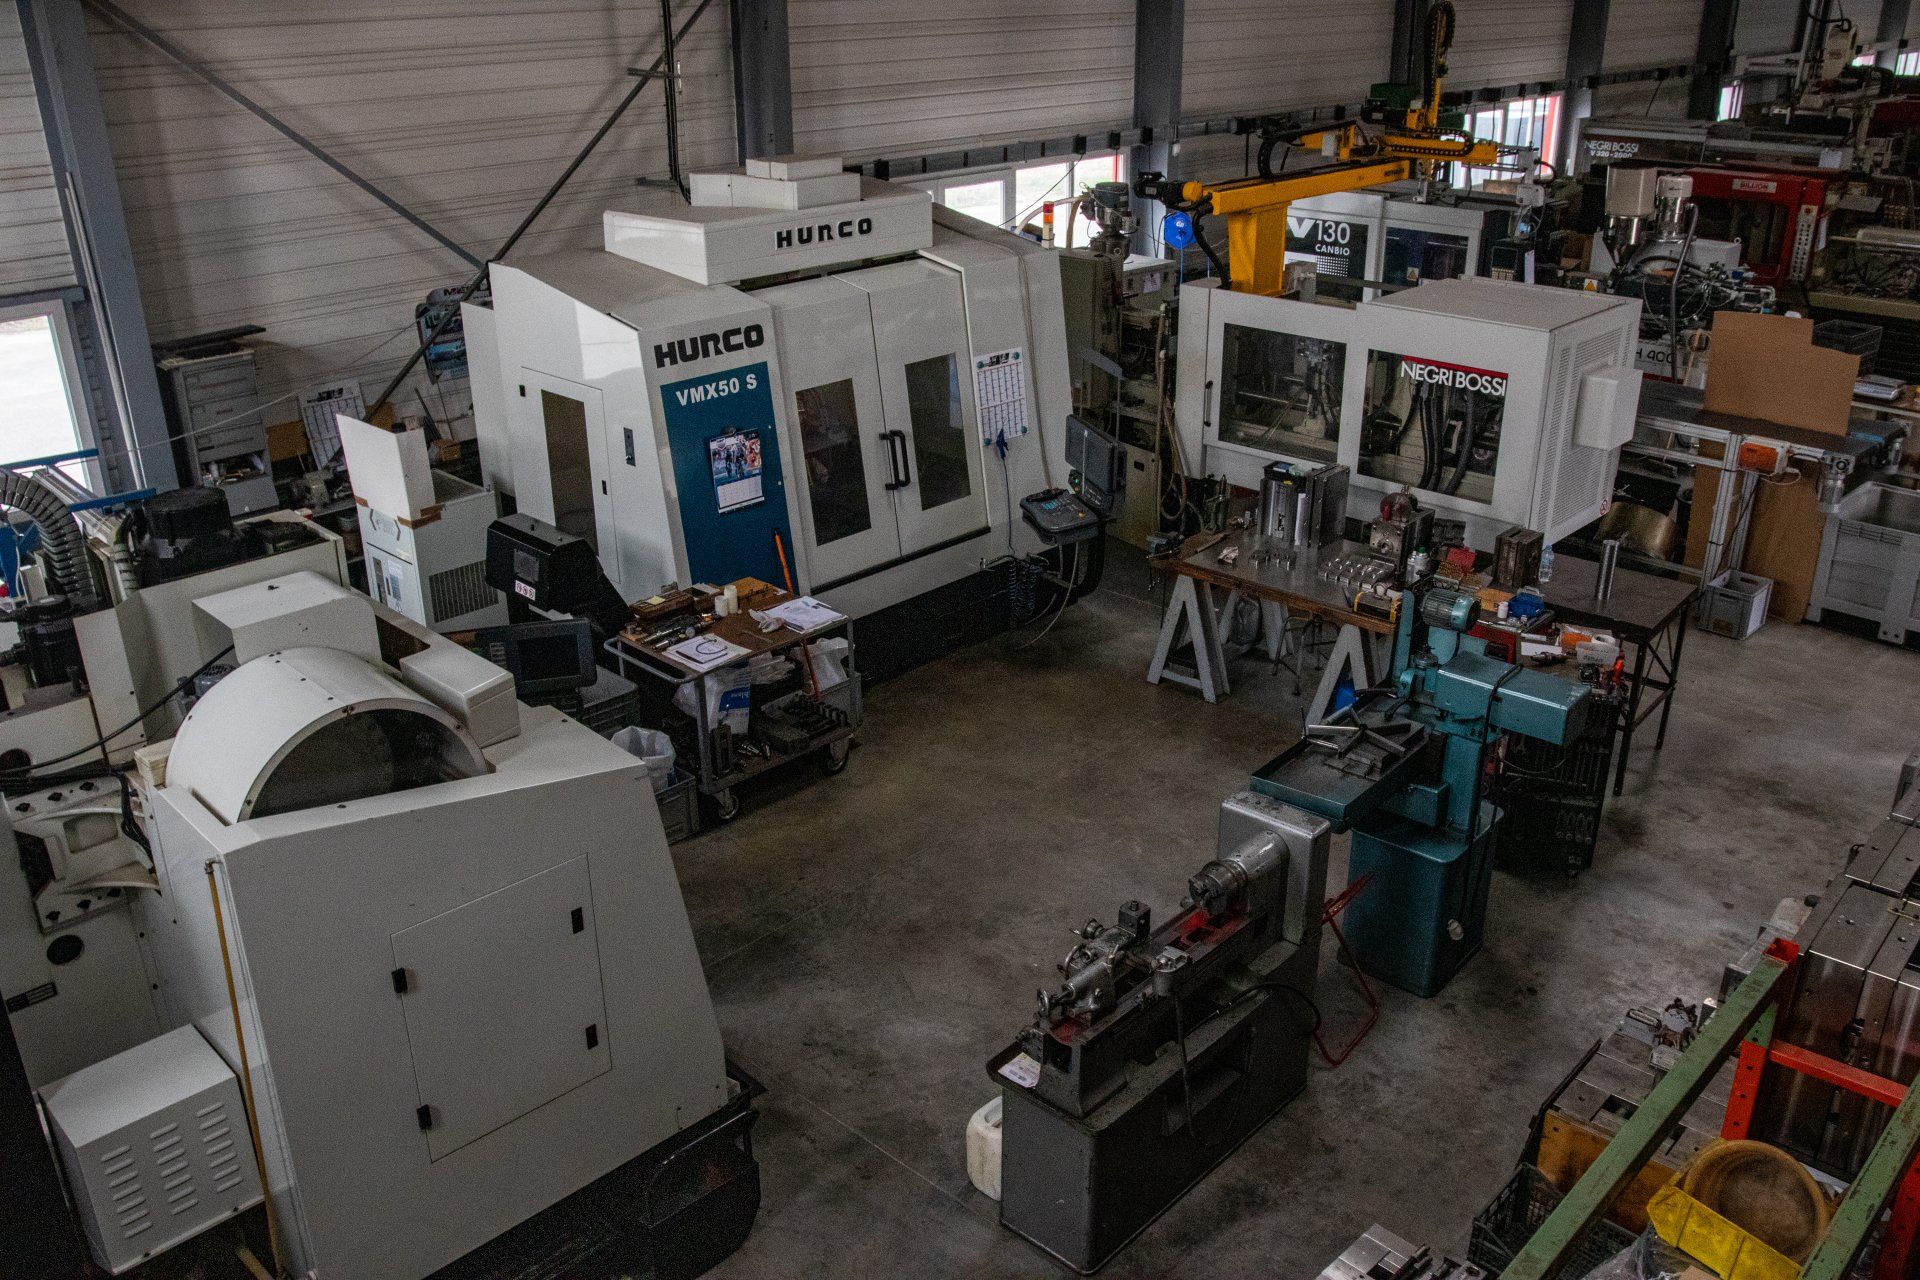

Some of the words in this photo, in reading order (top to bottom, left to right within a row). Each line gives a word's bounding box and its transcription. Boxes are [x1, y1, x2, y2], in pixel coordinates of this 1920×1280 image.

[776, 218, 872, 249] HURCO
[1315, 244, 1350, 256] CANBIO
[654, 324, 764, 368] HURCO
[675, 377, 740, 406] VMX50
[745, 373, 758, 390] S
[1400, 361, 1453, 387] NEGRI
[1455, 371, 1506, 397] BOSSI
